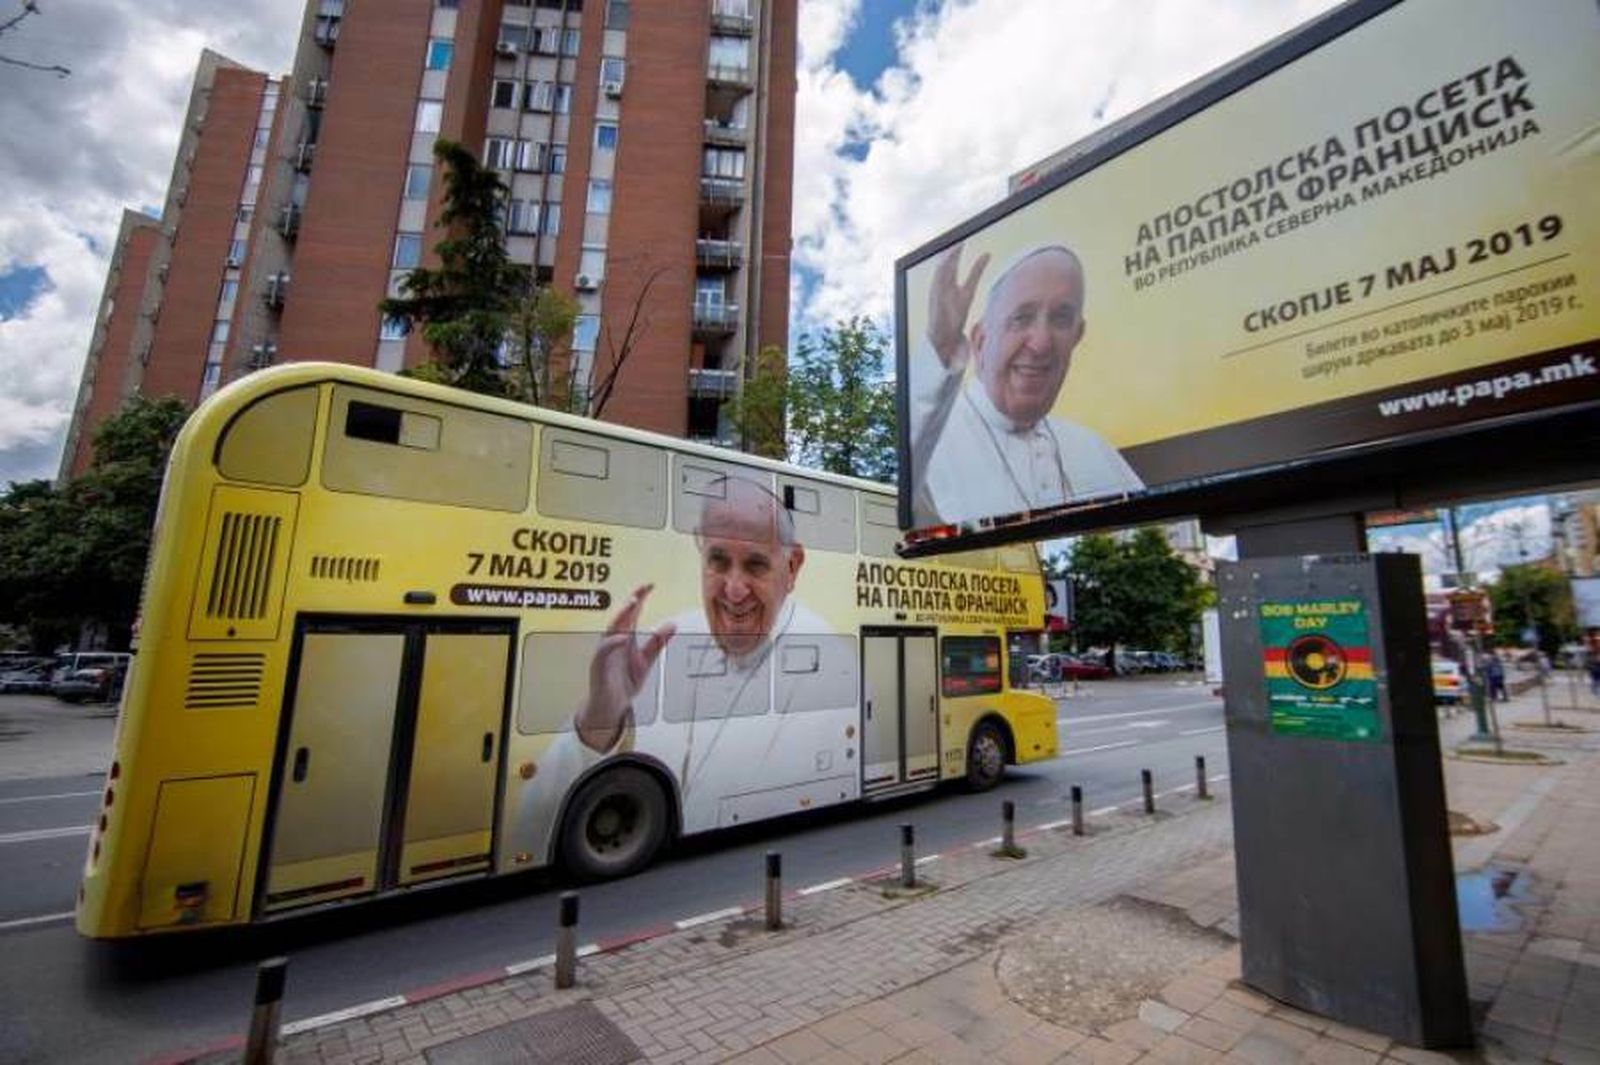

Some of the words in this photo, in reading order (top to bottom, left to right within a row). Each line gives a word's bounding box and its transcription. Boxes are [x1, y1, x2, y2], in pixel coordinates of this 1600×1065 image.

[1136, 137, 1346, 246] АПОСТОЛСКА
[1354, 56, 1526, 148] ПОСЕТА
[1124, 248, 1161, 276] НА
[1166, 194, 1290, 258] ПАПАТА
[1295, 84, 1535, 202] ФРАНЦИСК
[1134, 271, 1156, 292] ВО
[1158, 232, 1261, 283] РЕПУБЛИКА
[1264, 194, 1357, 239] СЕВЕРНА
[1361, 119, 1541, 199] МАКЕДОНИЈА
[1243, 282, 1353, 333] СКОПЈЕ
[1358, 275, 1377, 298] 7
[1386, 248, 1457, 290] МАЈ
[1468, 214, 1564, 264] 2019
[1463, 317, 1475, 337] 3
[1479, 310, 1512, 332] мај
[1516, 298, 1564, 324] 2019
[1378, 354, 1598, 416] www.papa.mk
[512, 528, 613, 558] СКОПЈЕ
[467, 553, 485, 575] 7
[489, 554, 548, 579] МАЈ
[554, 561, 611, 583] 2019
[856, 563, 969, 591] АПОСТОЛСКА
[971, 574, 1021, 595] ПОСЕТА
[467, 588, 601, 606] www.papa.mk
[857, 586, 884, 607] НА
[887, 588, 952, 611] ПАПАТА
[955, 594, 1029, 615] ФРАНЦИСК
